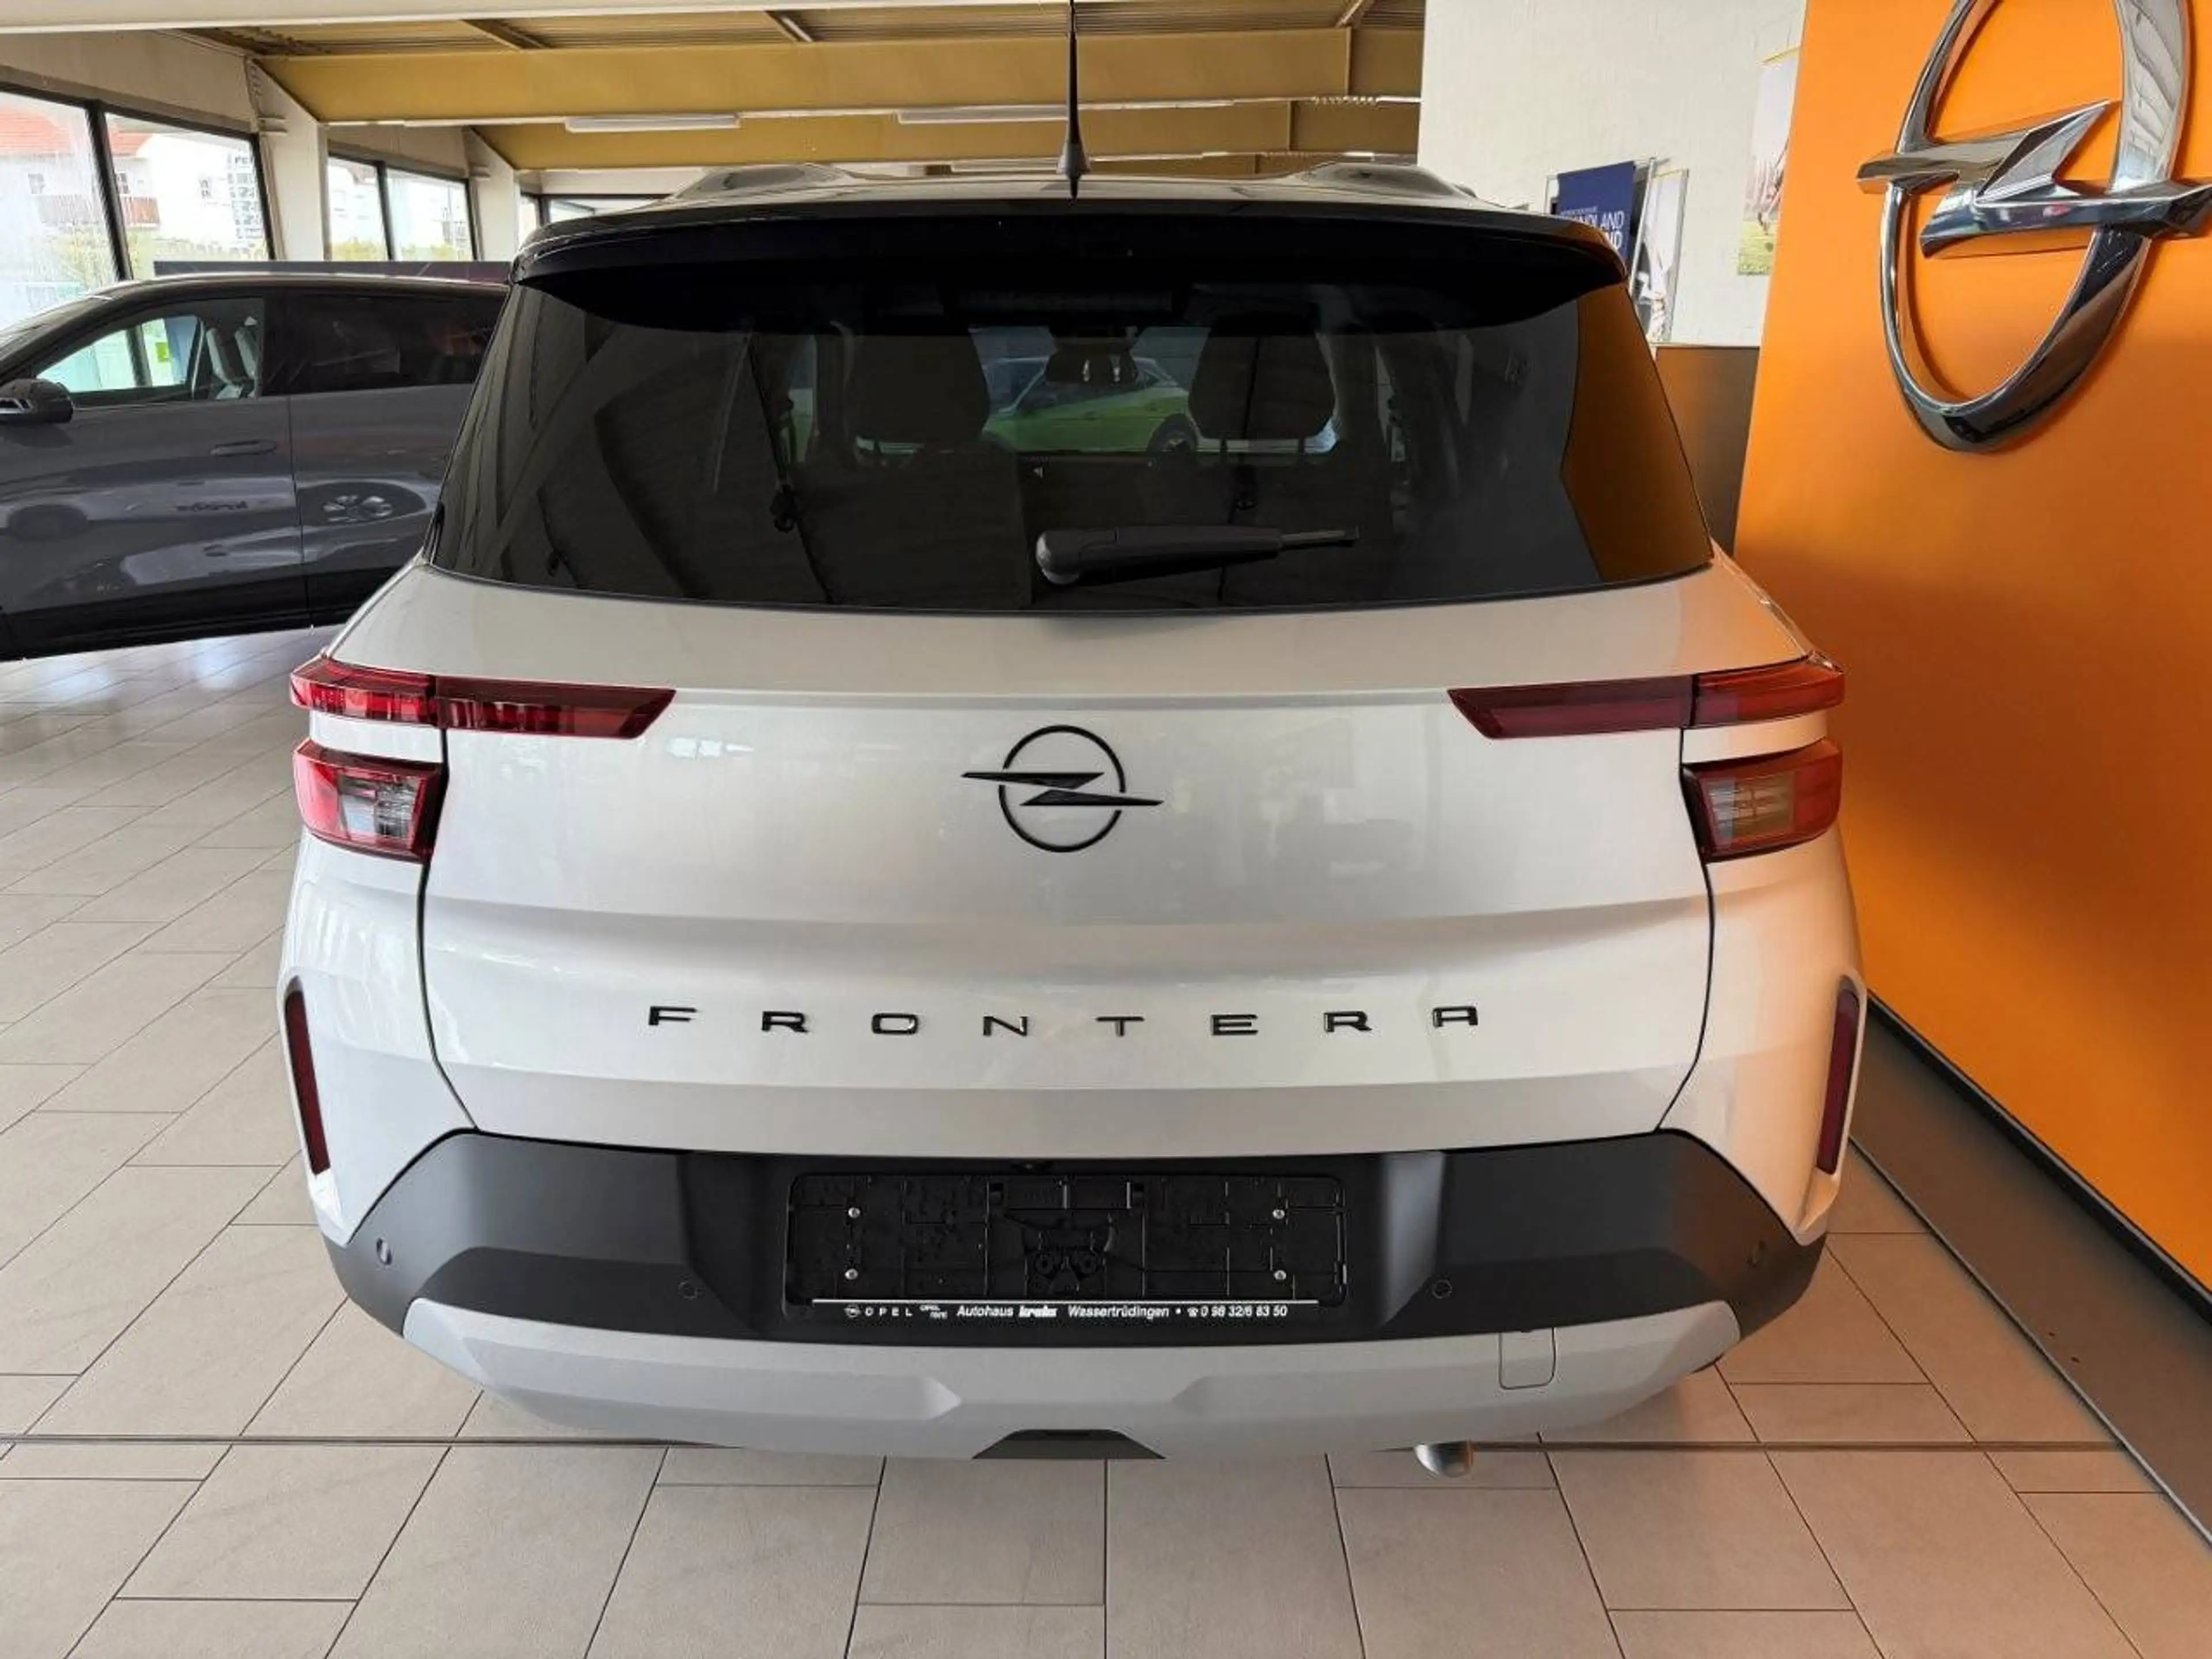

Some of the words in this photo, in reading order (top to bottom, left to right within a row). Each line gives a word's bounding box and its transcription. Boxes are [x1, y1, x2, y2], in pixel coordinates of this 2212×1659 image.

[648, 1005, 1479, 1037] FRONTERA
[865, 1308, 913, 1316] OPEL
[956, 1305, 1014, 1317] Autohaus
[1068, 1305, 1169, 1319] Wassertrüdingen
